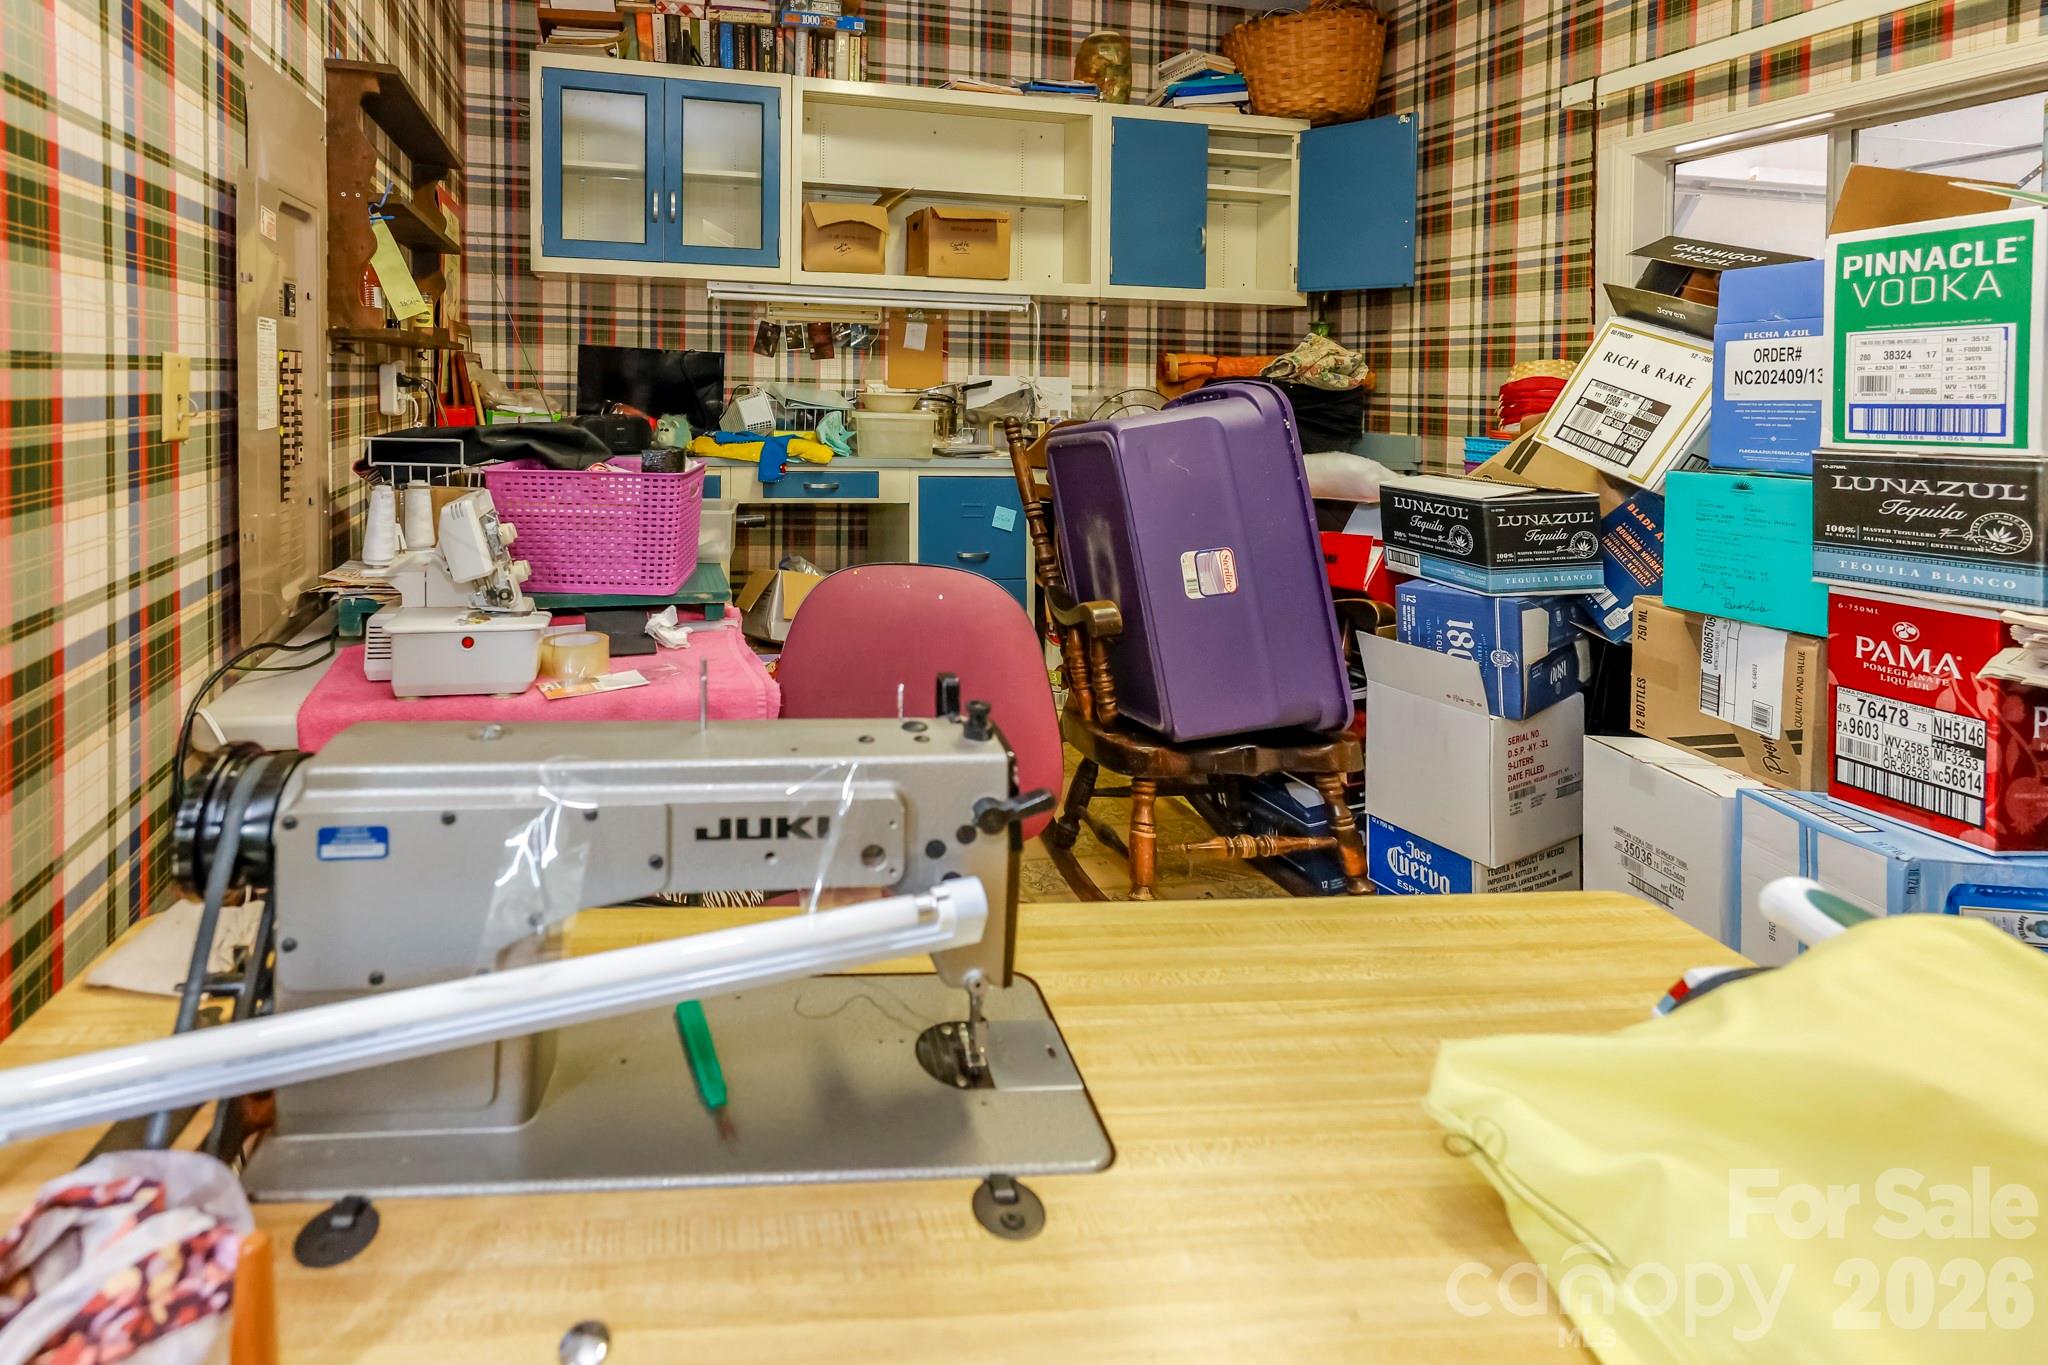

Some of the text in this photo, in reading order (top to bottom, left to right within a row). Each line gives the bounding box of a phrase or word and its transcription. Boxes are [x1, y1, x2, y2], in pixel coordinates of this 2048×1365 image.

[802, 15, 820, 26] 1000
[1671, 252, 1736, 267] MEZCAL
[1672, 243, 1768, 264] CASAMIGOS
[1843, 236, 2018, 280] PINNACLE
[1853, 270, 2002, 308] VODKA
[1656, 306, 1687, 320] Joven
[1744, 331, 1780, 340] FLECHA
[1754, 346, 1802, 363] ORDER#
[1883, 350, 1912, 360] 38324
[1603, 351, 1696, 389] RICH & RARE
[1832, 475, 2027, 501] LUNAZUL
[1393, 496, 1469, 520] LUNAZUL
[1497, 511, 1594, 527] LUNAZUL
[1627, 503, 1657, 532] BLADE
[1878, 499, 1968, 523] Tequila
[1410, 515, 1445, 534] Tequila
[1825, 524, 1856, 533] 100%
[1863, 526, 1937, 538] MASTER TEQUILERO
[1524, 528, 1569, 546] Tequila
[1615, 525, 1642, 552] BOURBON
[1863, 536, 1894, 544] JALISCO,
[1627, 563, 1652, 588] KENTUCKY
[1838, 560, 2017, 590] TEQUILA BLANCO
[1406, 594, 1416, 603] 12
[1838, 602, 1880, 615] 6-750ML
[1446, 619, 1475, 661] 180
[1703, 616, 1717, 664] 806605705
[1636, 609, 1648, 730] 12 BOTTLES 750 ML
[1855, 636, 1963, 680] PAMA
[1863, 662, 1950, 687] POMEGRANATE
[1880, 674, 1930, 691] LIQUEUR
[1794, 650, 1806, 728] QUALITY AND VALUE
[1838, 698, 1927, 732] 475 76478 75
[2033, 706, 2048, 739] P
[1508, 730, 1540, 745] SERIAL NO
[1884, 734, 1929, 758] WV-2585
[1508, 755, 1534, 770] 9-LITERS
[1934, 749, 1979, 771] MI-3253
[1508, 764, 1544, 783] DATE FILLED
[695, 816, 830, 840] JUKI
[1406, 841, 1432, 865] Jose
[1514, 854, 1538, 868] PRODUCT
[1539, 853, 1545, 861] OF
[1546, 846, 1565, 859] MEXICO
[1624, 840, 1652, 866] 35036
[1387, 846, 1450, 895] Cuervo
[1487, 874, 1510, 886] IMPORTED
[1397, 878, 1424, 895] ESPEC
